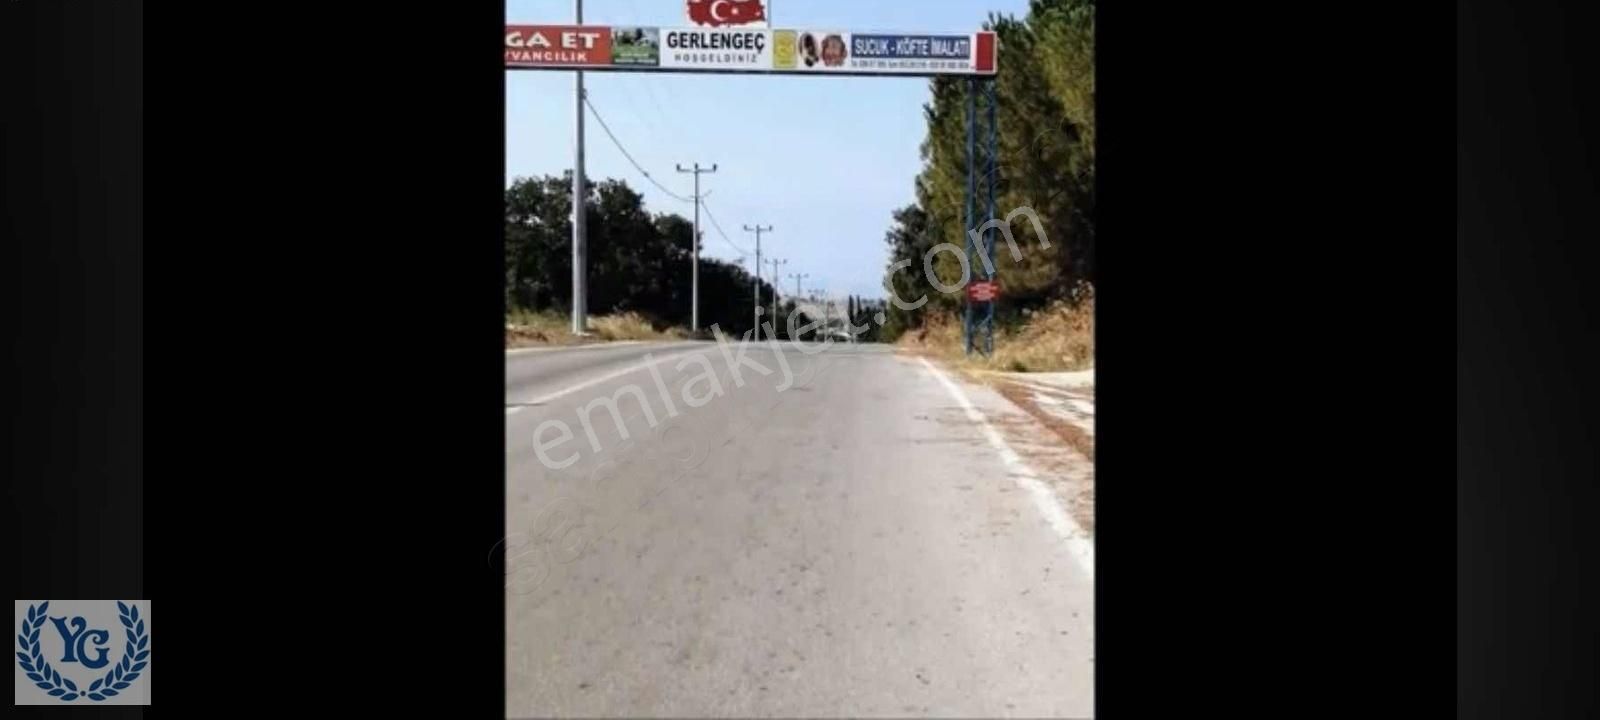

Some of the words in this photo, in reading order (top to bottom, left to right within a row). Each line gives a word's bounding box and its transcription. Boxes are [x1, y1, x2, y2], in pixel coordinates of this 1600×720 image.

[561, 32, 600, 49] ET
[666, 31, 765, 53] GERLENGEÇ
[855, 38, 889, 55] SUCUK
[896, 38, 929, 56] KÖFTE
